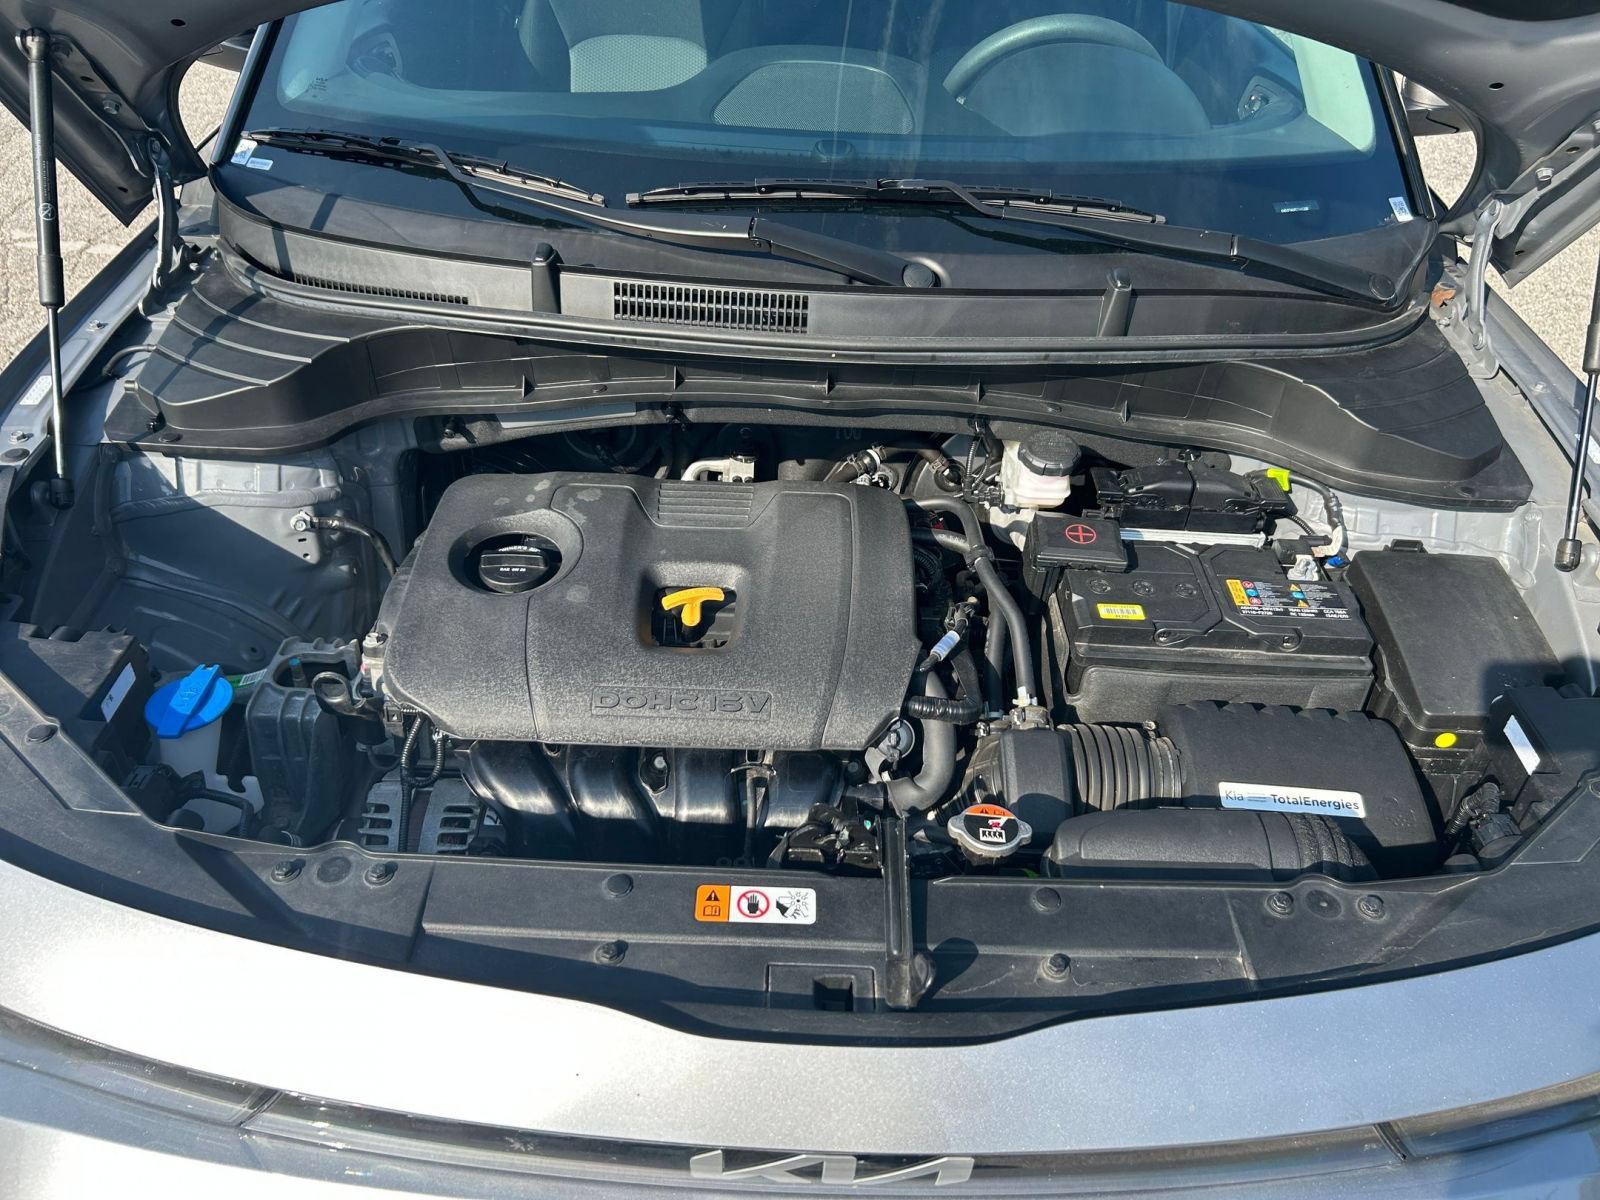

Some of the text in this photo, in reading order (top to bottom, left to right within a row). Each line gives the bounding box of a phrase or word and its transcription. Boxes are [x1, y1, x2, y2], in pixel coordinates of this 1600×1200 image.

[593, 690, 770, 714] DOHC 16V
[1224, 790, 1360, 810] Kia TotalEnergies
[689, 1149, 975, 1185] KIA
